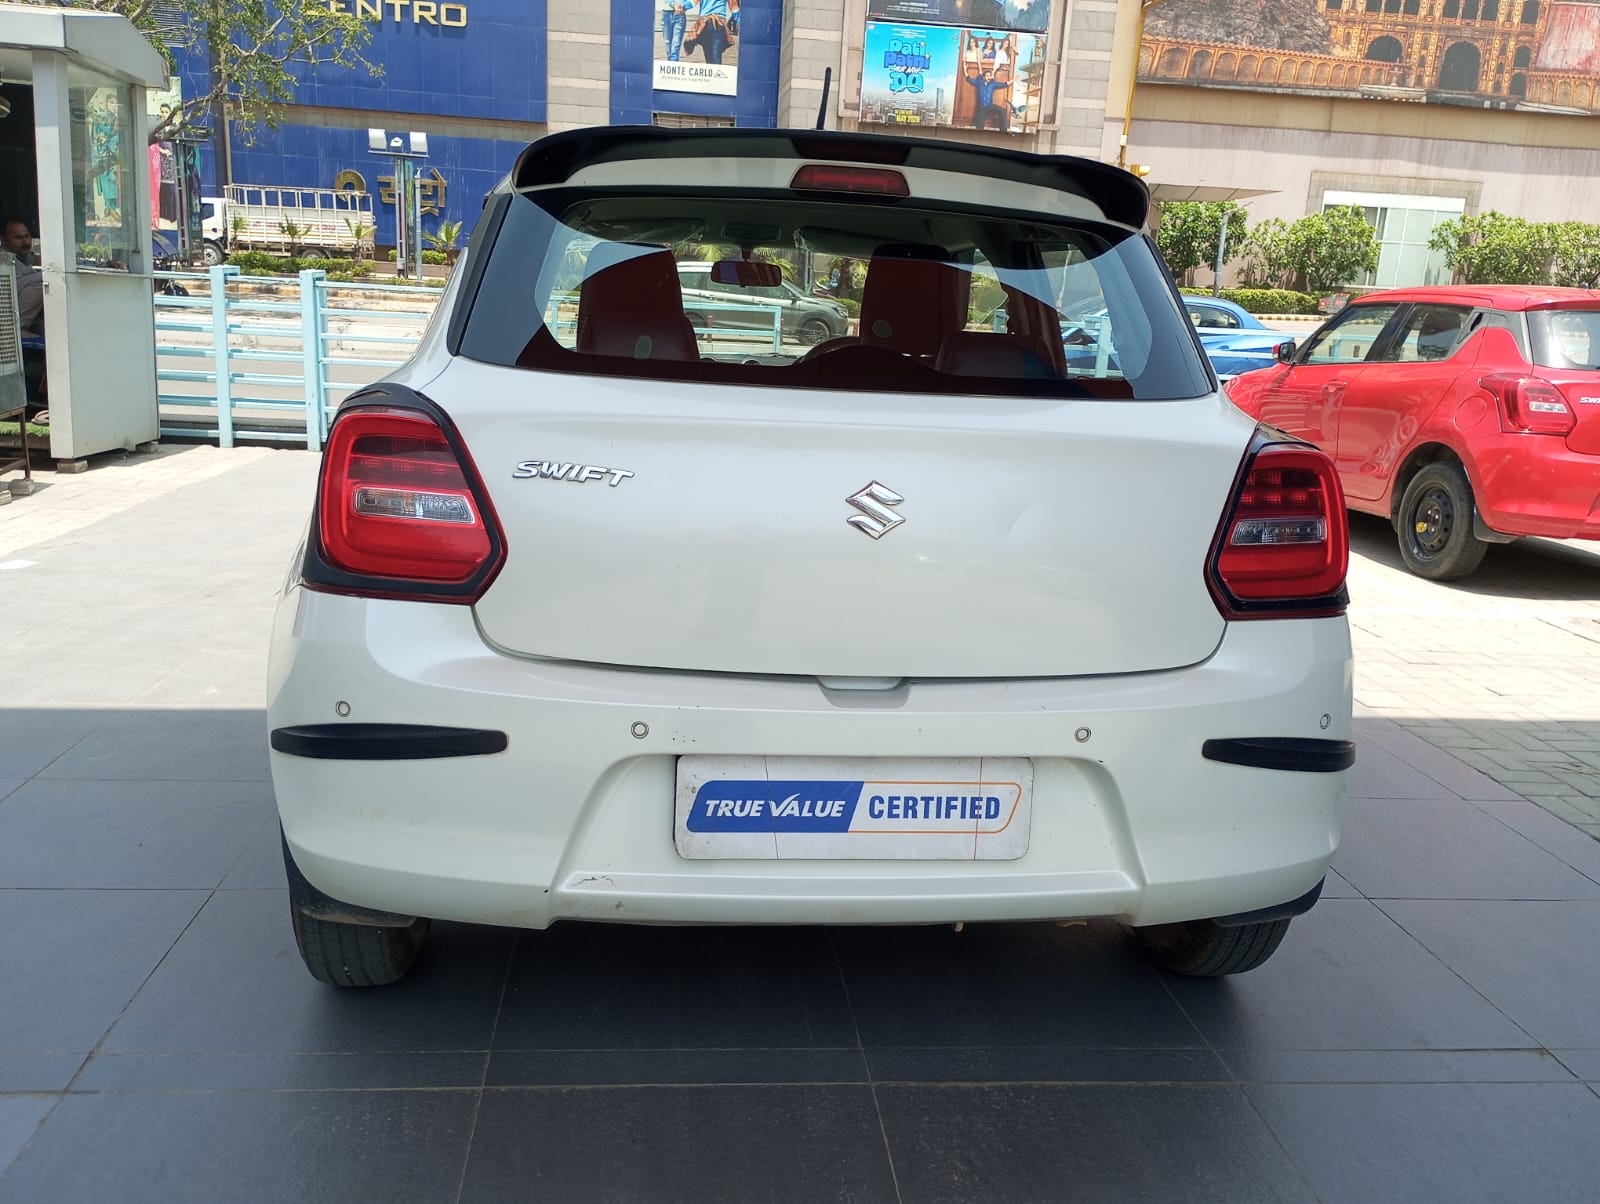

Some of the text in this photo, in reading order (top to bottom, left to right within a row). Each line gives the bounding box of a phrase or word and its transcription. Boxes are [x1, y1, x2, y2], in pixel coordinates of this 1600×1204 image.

[659, 65, 713, 77] MONTE CARLO
[512, 460, 635, 487] SWIFT
[705, 793, 1000, 820] TRUE VALUE CERTIFIED
